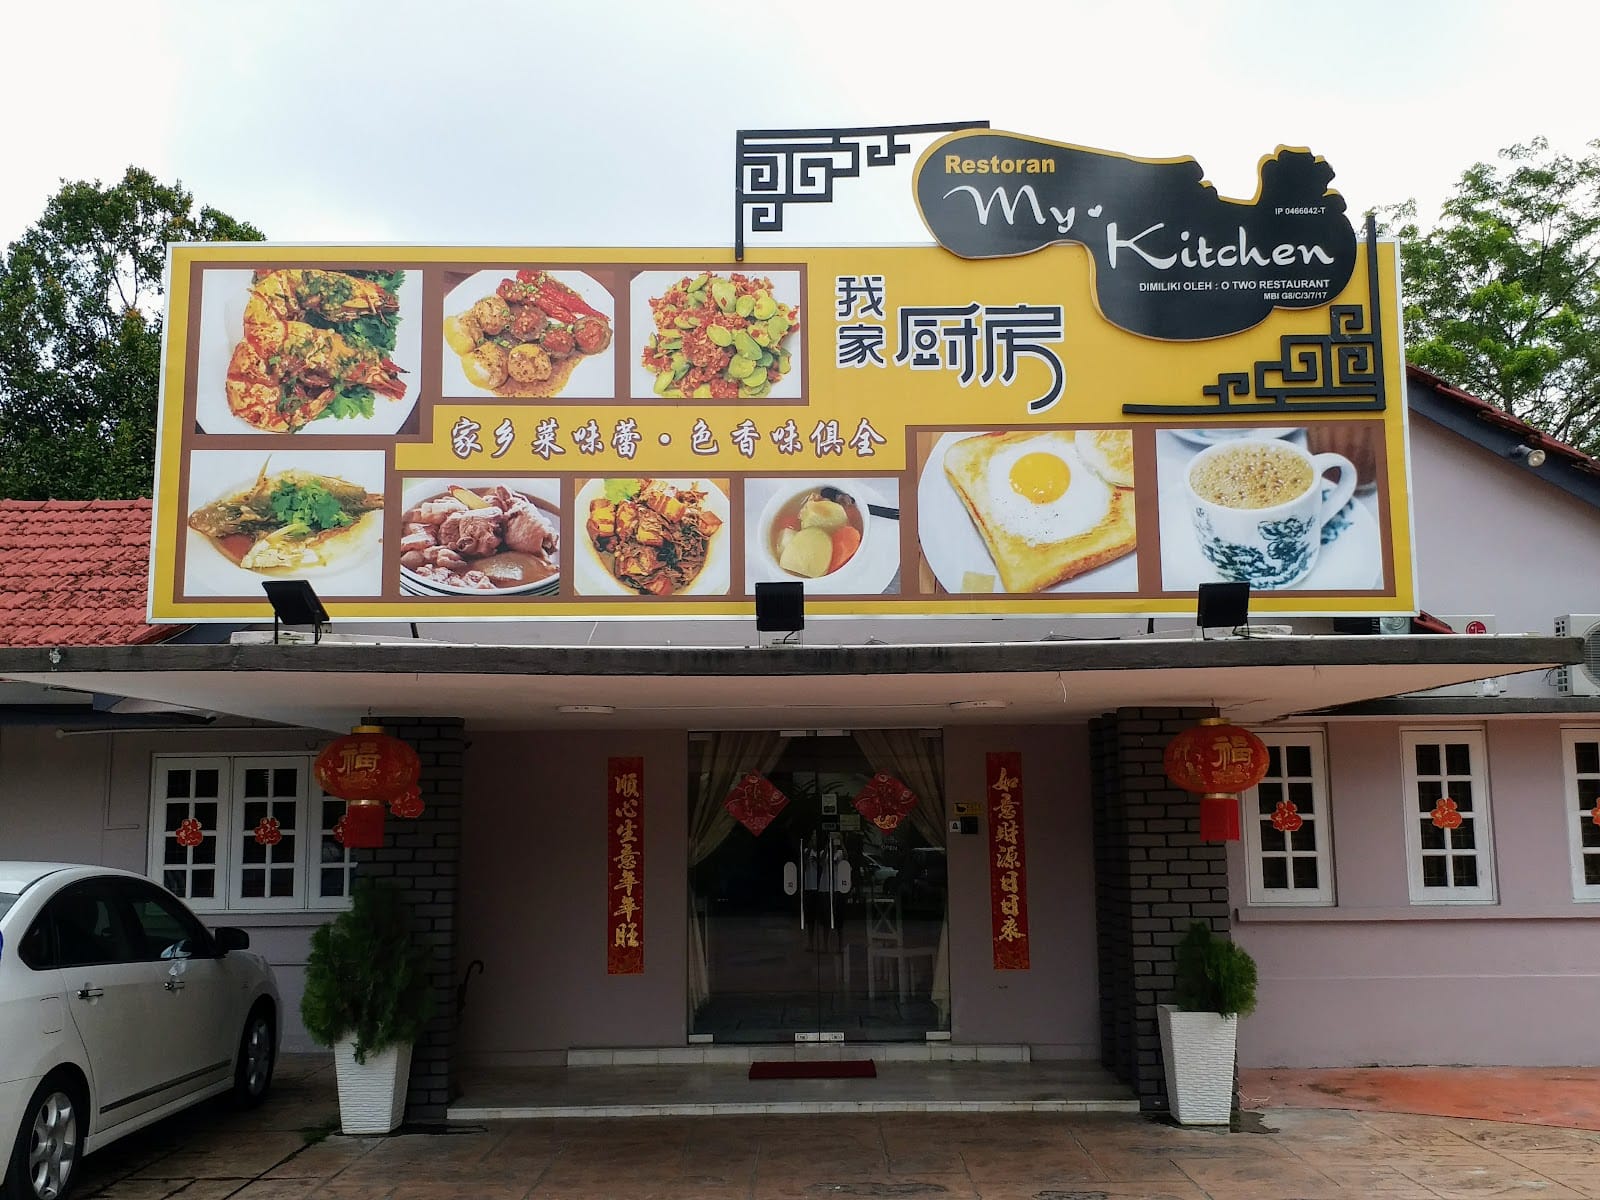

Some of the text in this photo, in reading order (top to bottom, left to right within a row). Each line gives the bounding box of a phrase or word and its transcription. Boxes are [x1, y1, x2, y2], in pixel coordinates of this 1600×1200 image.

[945, 155, 1056, 174] Restoran
[942, 184, 1076, 234] My
[1274, 206, 1283, 215] IP
[1106, 222, 1335, 270] Kitchen
[1138, 282, 1181, 292] DIMILIKI
[1183, 282, 1212, 291] OLEH
[1232, 281, 1257, 290] TWO
[1259, 279, 1330, 289] RESTAURANT
[1263, 292, 1280, 300] MBI
[836, 275, 1066, 415] 我家 厨房
